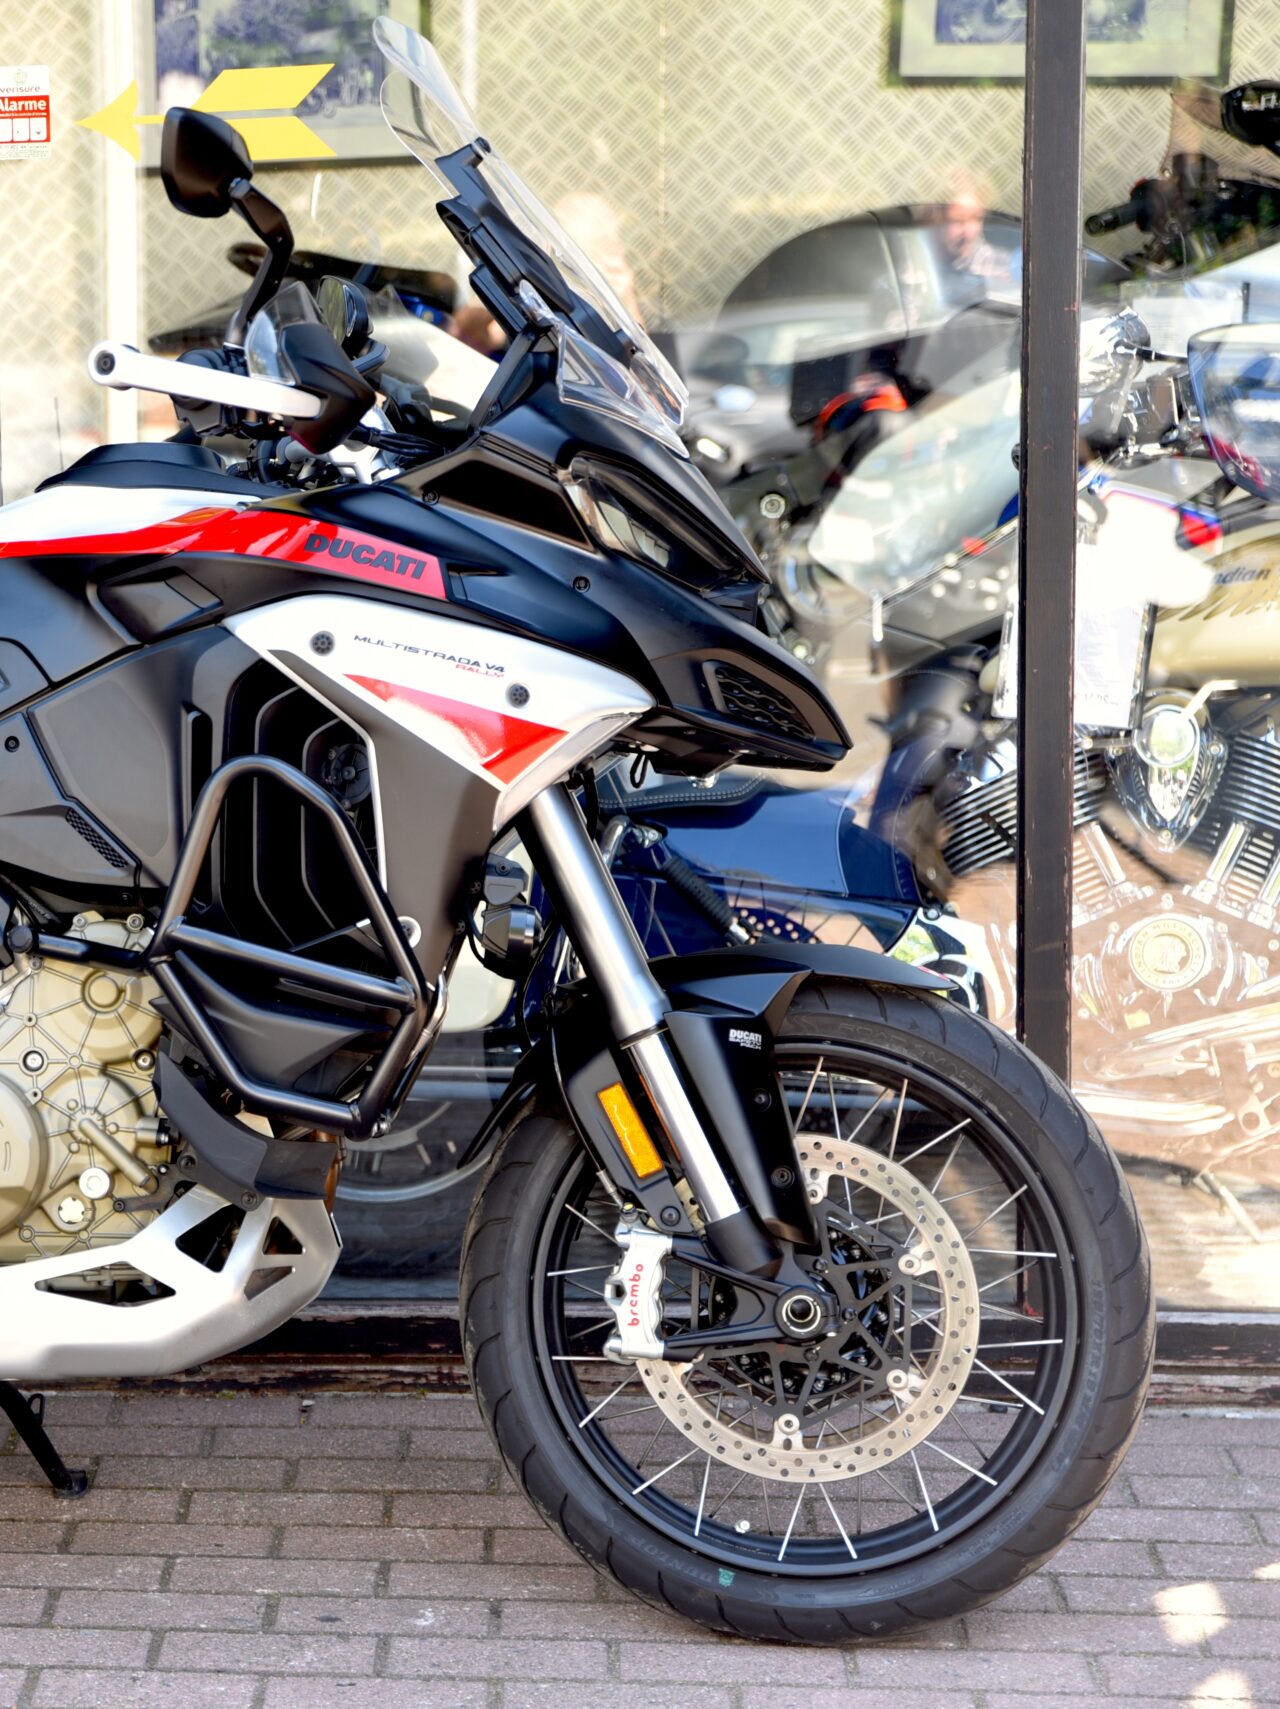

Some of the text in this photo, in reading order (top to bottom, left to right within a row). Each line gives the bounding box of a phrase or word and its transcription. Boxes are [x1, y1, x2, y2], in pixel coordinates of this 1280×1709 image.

[0, 86, 41, 94] verisure
[303, 532, 428, 580] DUCATI
[1214, 565, 1272, 585] ndian
[353, 634, 506, 673] MULTISTRADA V4
[455, 664, 505, 678] RALLY
[729, 1028, 762, 1044] DUCATI
[627, 1263, 644, 1327] brembo
